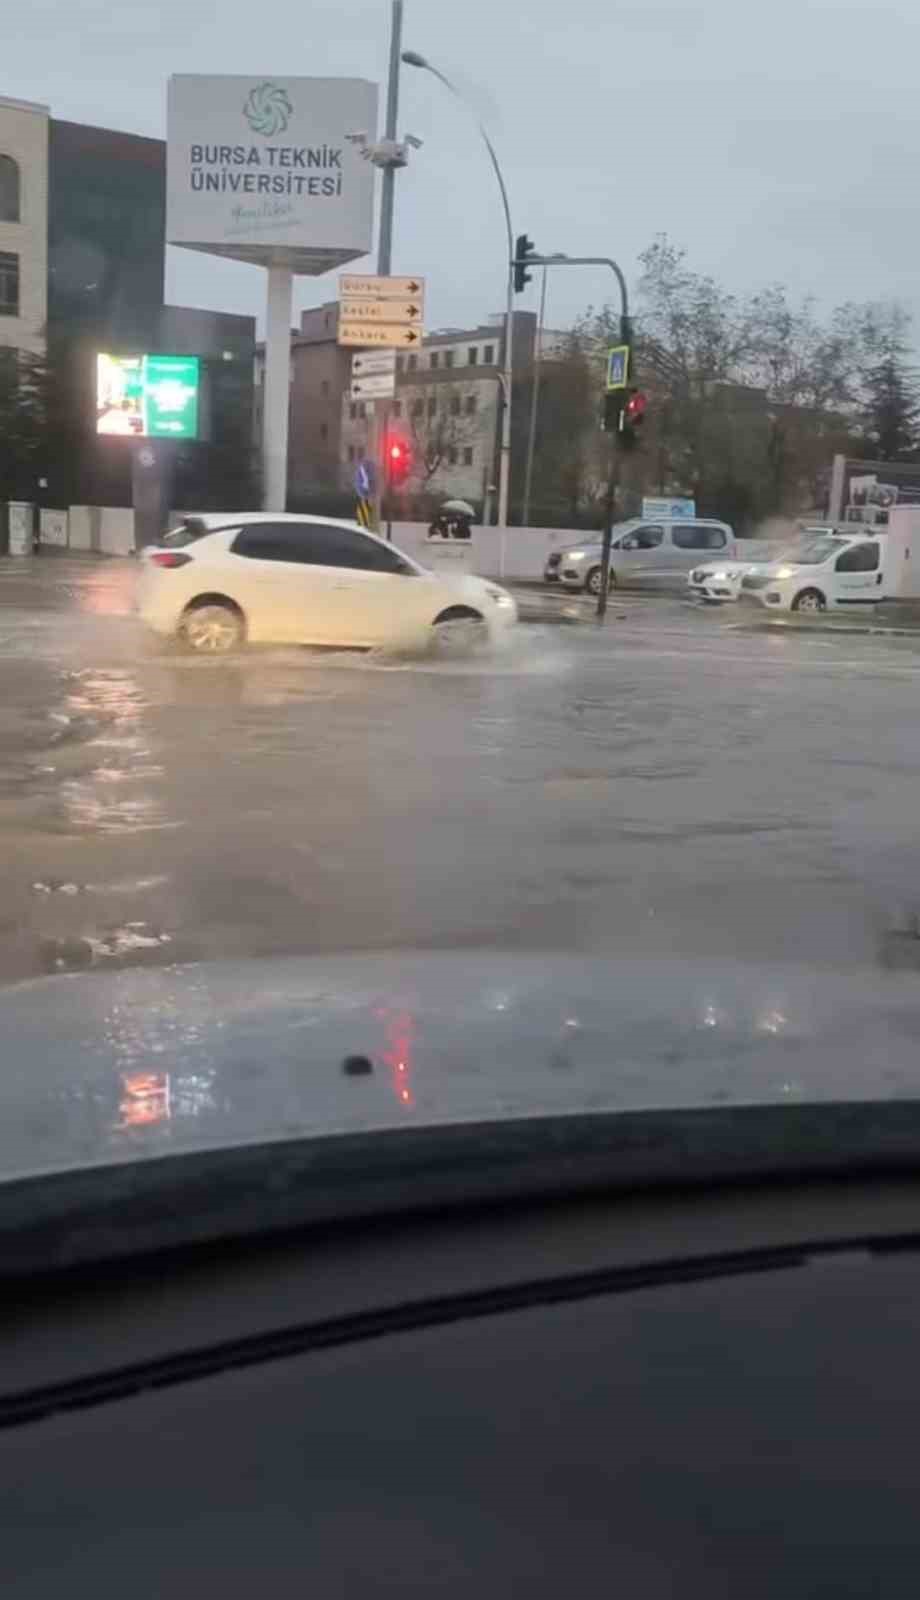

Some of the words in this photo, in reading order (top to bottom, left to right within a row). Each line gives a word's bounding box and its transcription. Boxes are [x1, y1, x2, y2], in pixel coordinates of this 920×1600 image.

[191, 145, 260, 165] BURSA
[267, 144, 342, 168] TEKNİK
[191, 167, 342, 196] ÜNİVERSİTESİ
